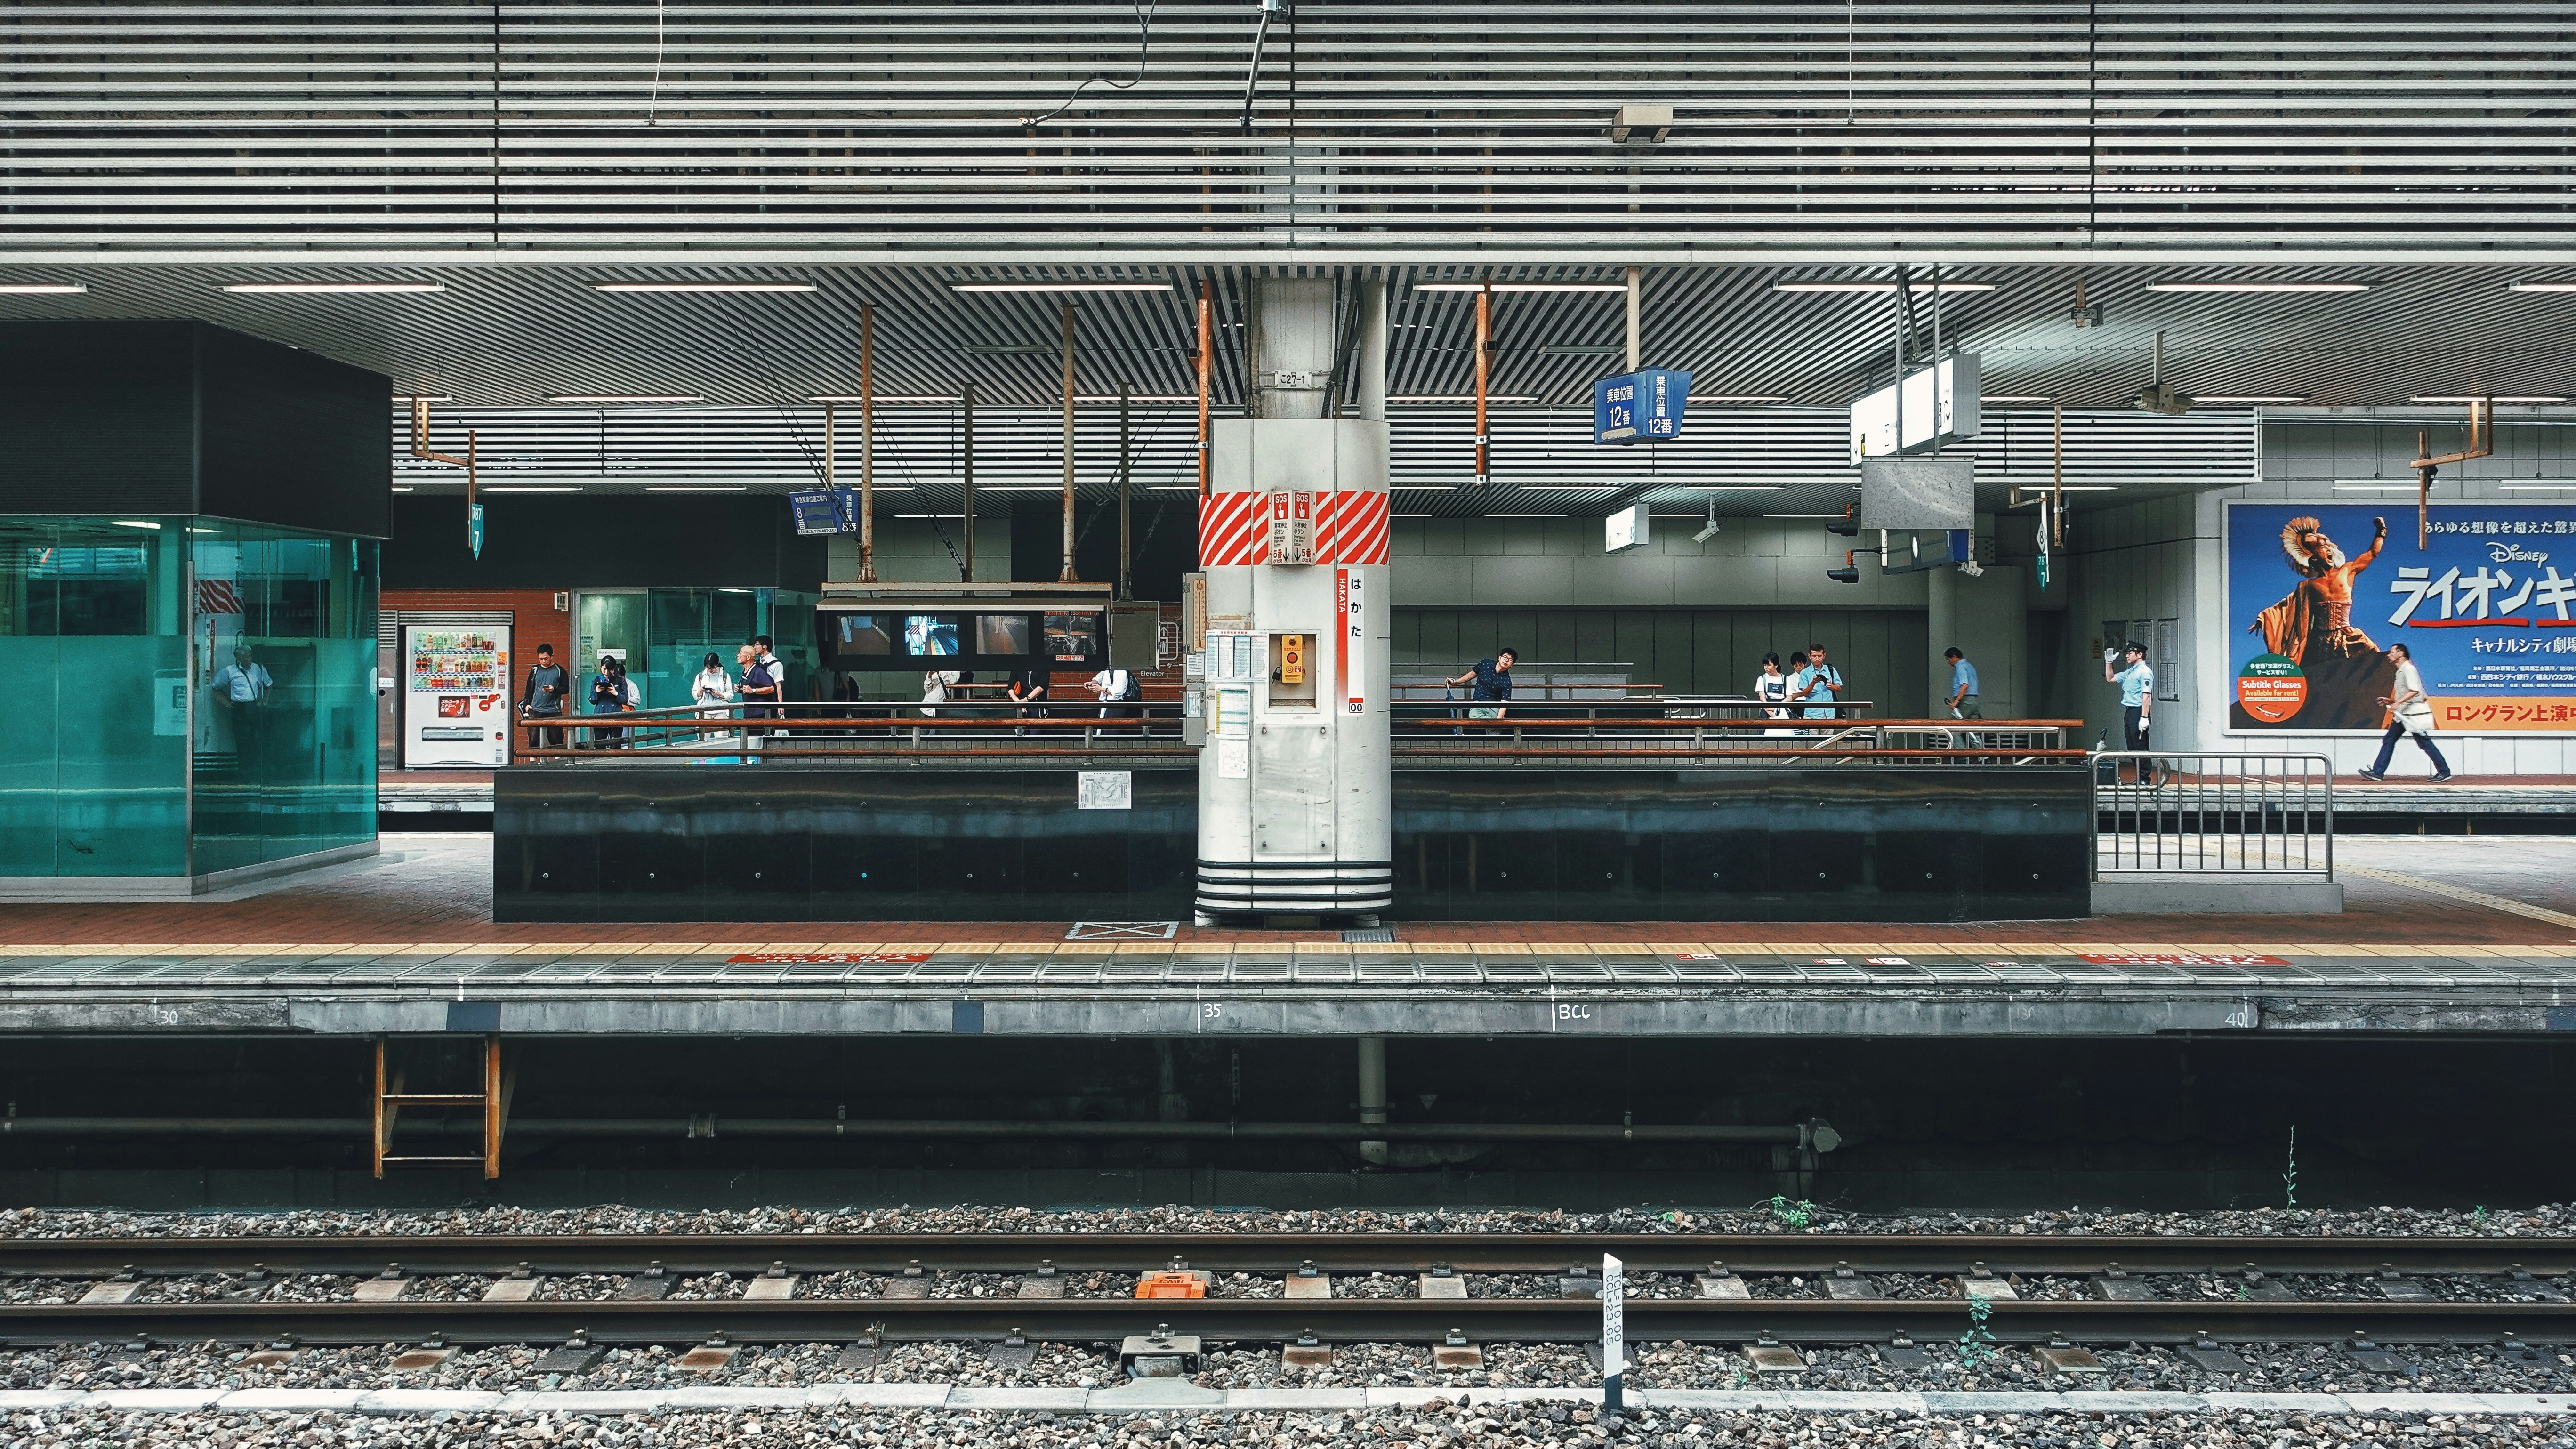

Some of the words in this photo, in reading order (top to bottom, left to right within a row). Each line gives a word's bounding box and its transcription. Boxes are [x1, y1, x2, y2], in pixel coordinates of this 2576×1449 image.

[1607, 385, 1634, 403] 乗車位置
[1656, 376, 1666, 417] 乗車位置
[1609, 406, 1630, 427] 12番
[1648, 418, 1672, 434] 12番
[1275, 495, 1287, 503] SOS
[1296, 494, 1309, 502] SOS
[472, 507, 482, 521] 787
[474, 530, 479, 551] 7
[2040, 530, 2044, 545] 8
[1273, 549, 1282, 559] 5番
[1302, 548, 1311, 558] 5番
[2041, 572, 2045, 587] 7
[2387, 565, 2576, 628] ライオンキ
[1351, 578, 1362, 637] はかた
[2242, 680, 2271, 689] Subtitle
[2273, 680, 2302, 689] Glasses
[1350, 703, 1362, 712] 00
[160, 1010, 178, 1024] 30
[1204, 1003, 1222, 1018] 35
[1559, 1004, 1591, 1019] BCC
[2224, 1012, 2245, 1028] 40
[1606, 1274, 1614, 1345] CCL=23.65
[1614, 1272, 1622, 1342] TCL=10.00
